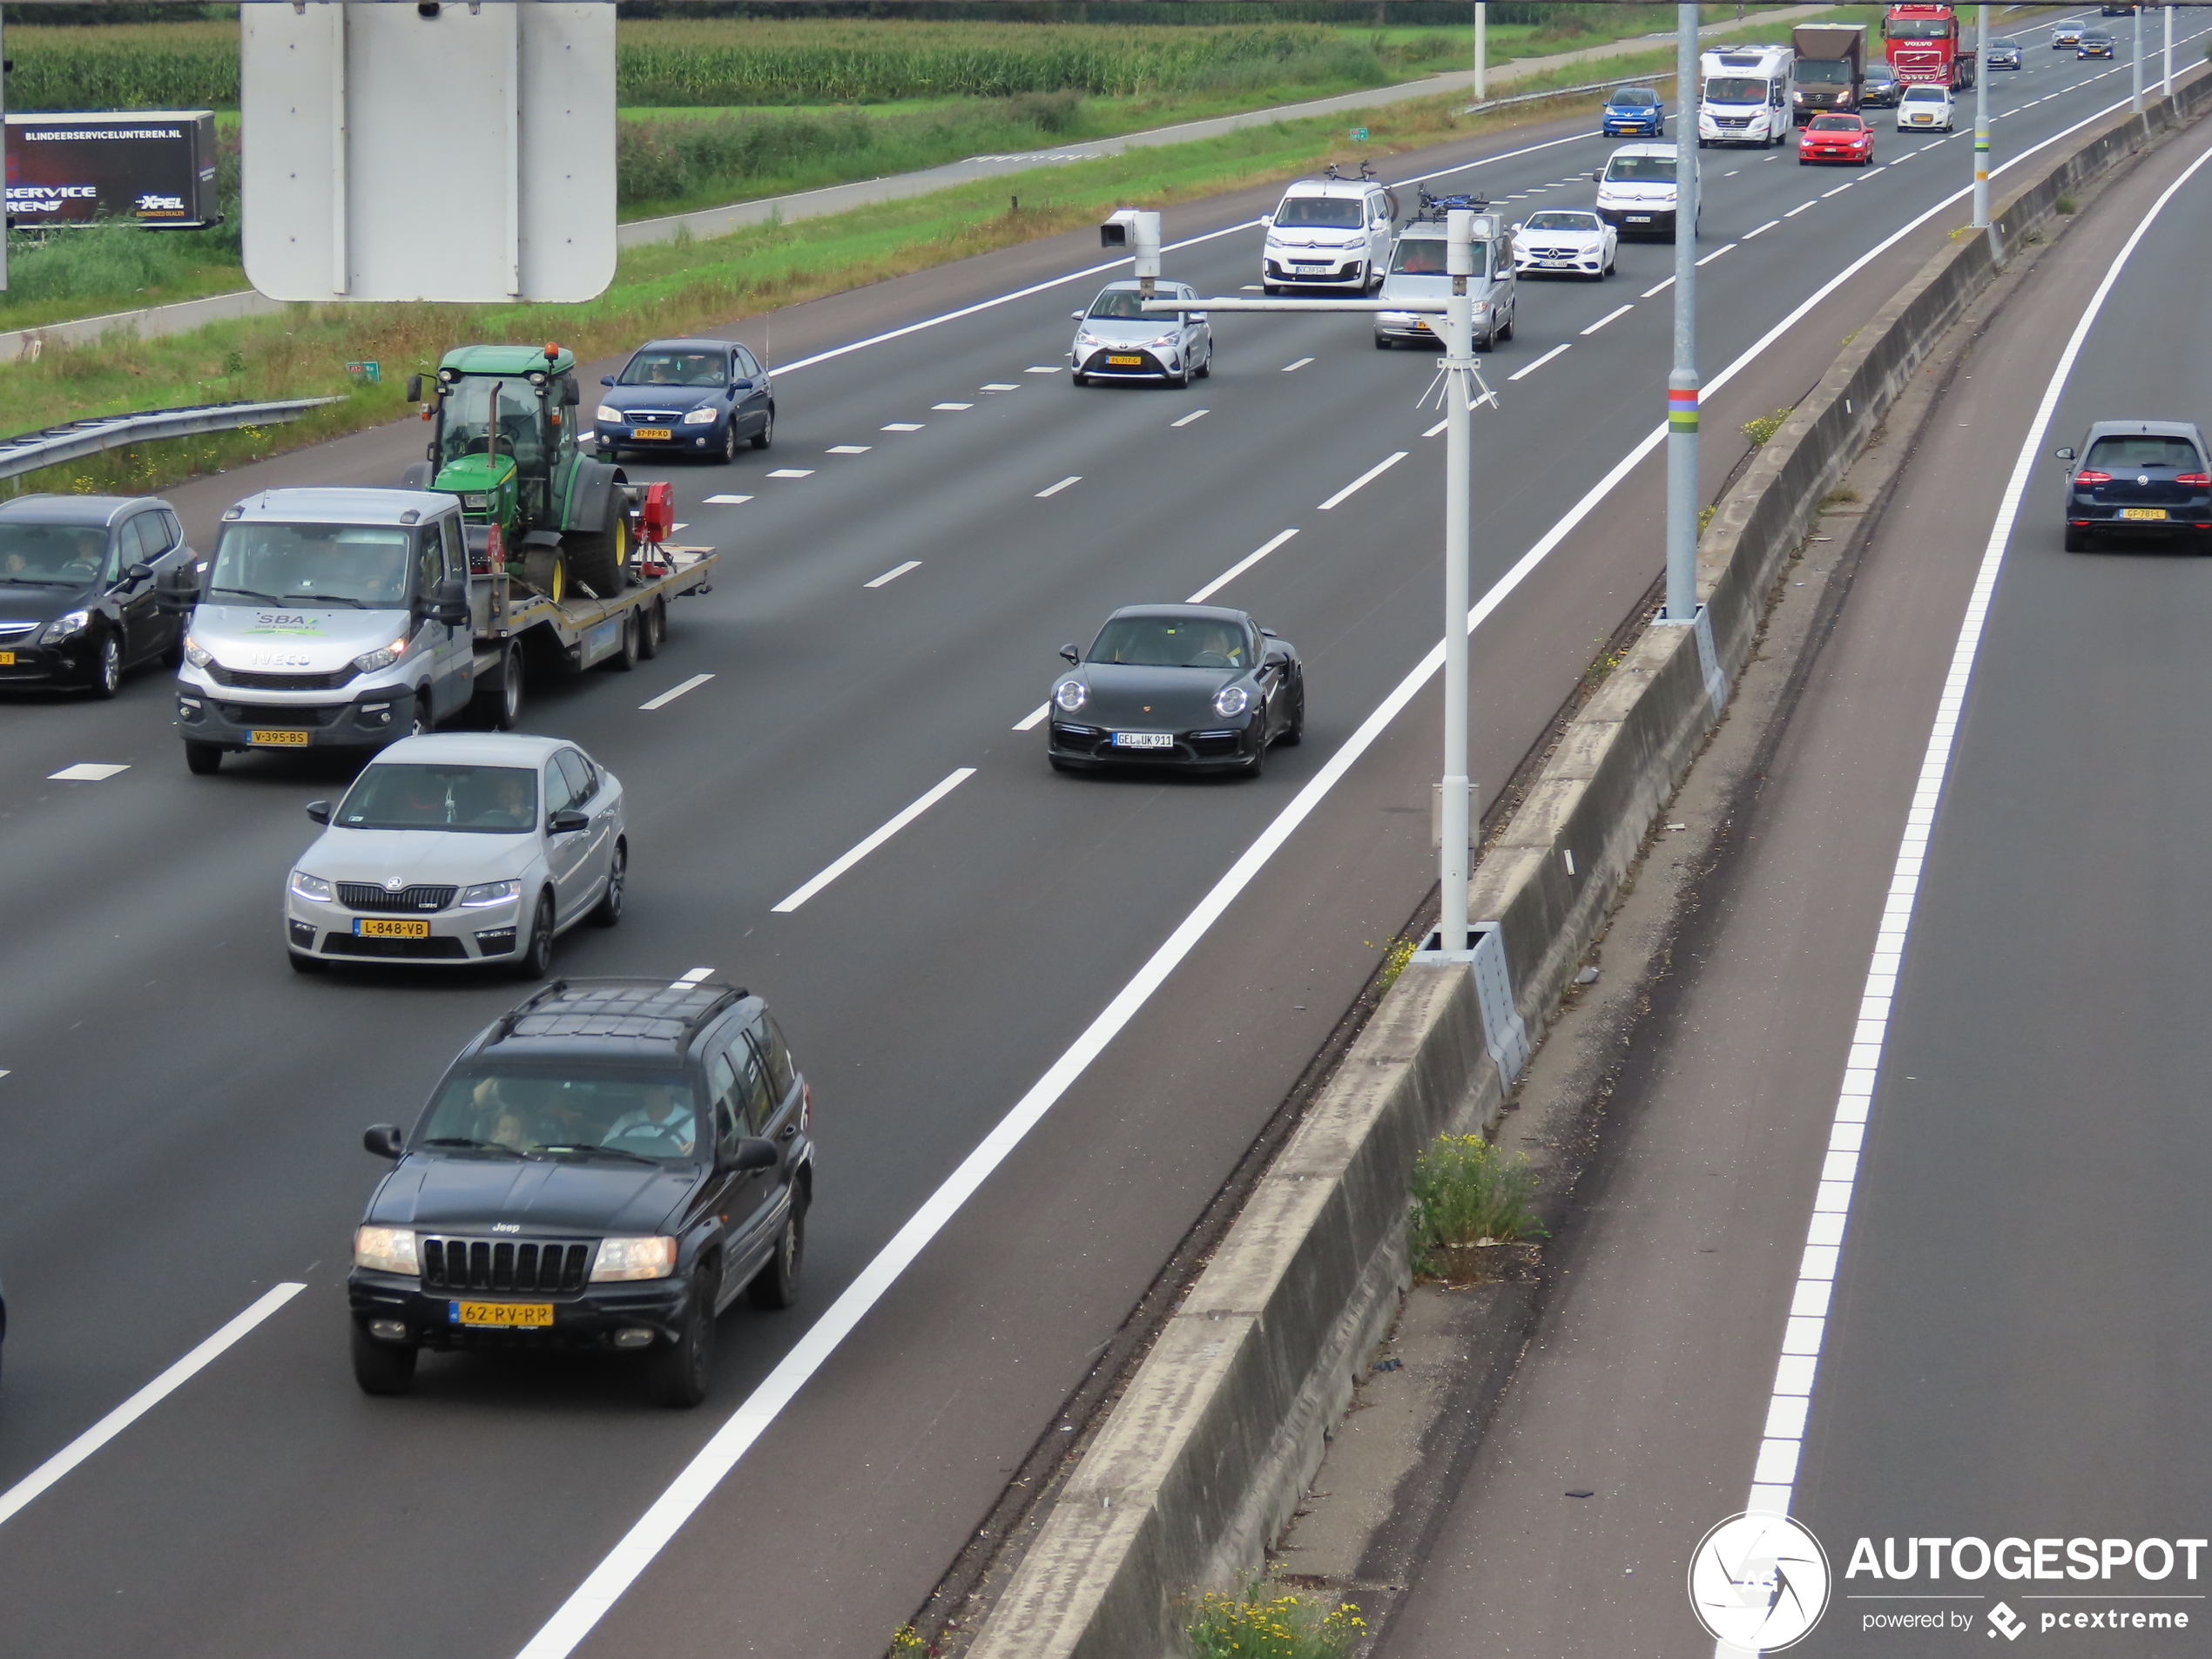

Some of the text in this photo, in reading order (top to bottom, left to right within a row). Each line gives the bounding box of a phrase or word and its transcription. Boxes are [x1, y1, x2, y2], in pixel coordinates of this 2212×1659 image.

[25, 129, 182, 141] BLINDEERSERVICELUNTEREN.NL
[5, 186, 97, 199] SERVICE
[141, 195, 185, 210] XPEL
[2127, 509, 2161, 518] GF-781-L
[258, 614, 305, 624] SBA
[251, 652, 311, 666] IVECO
[254, 732, 304, 743] V-395-BS
[1118, 734, 1171, 745] GEL UK 911
[365, 921, 424, 935] L-848-VB
[491, 1222, 521, 1234] Jeep
[465, 1305, 548, 1323] 62-RV-RR
